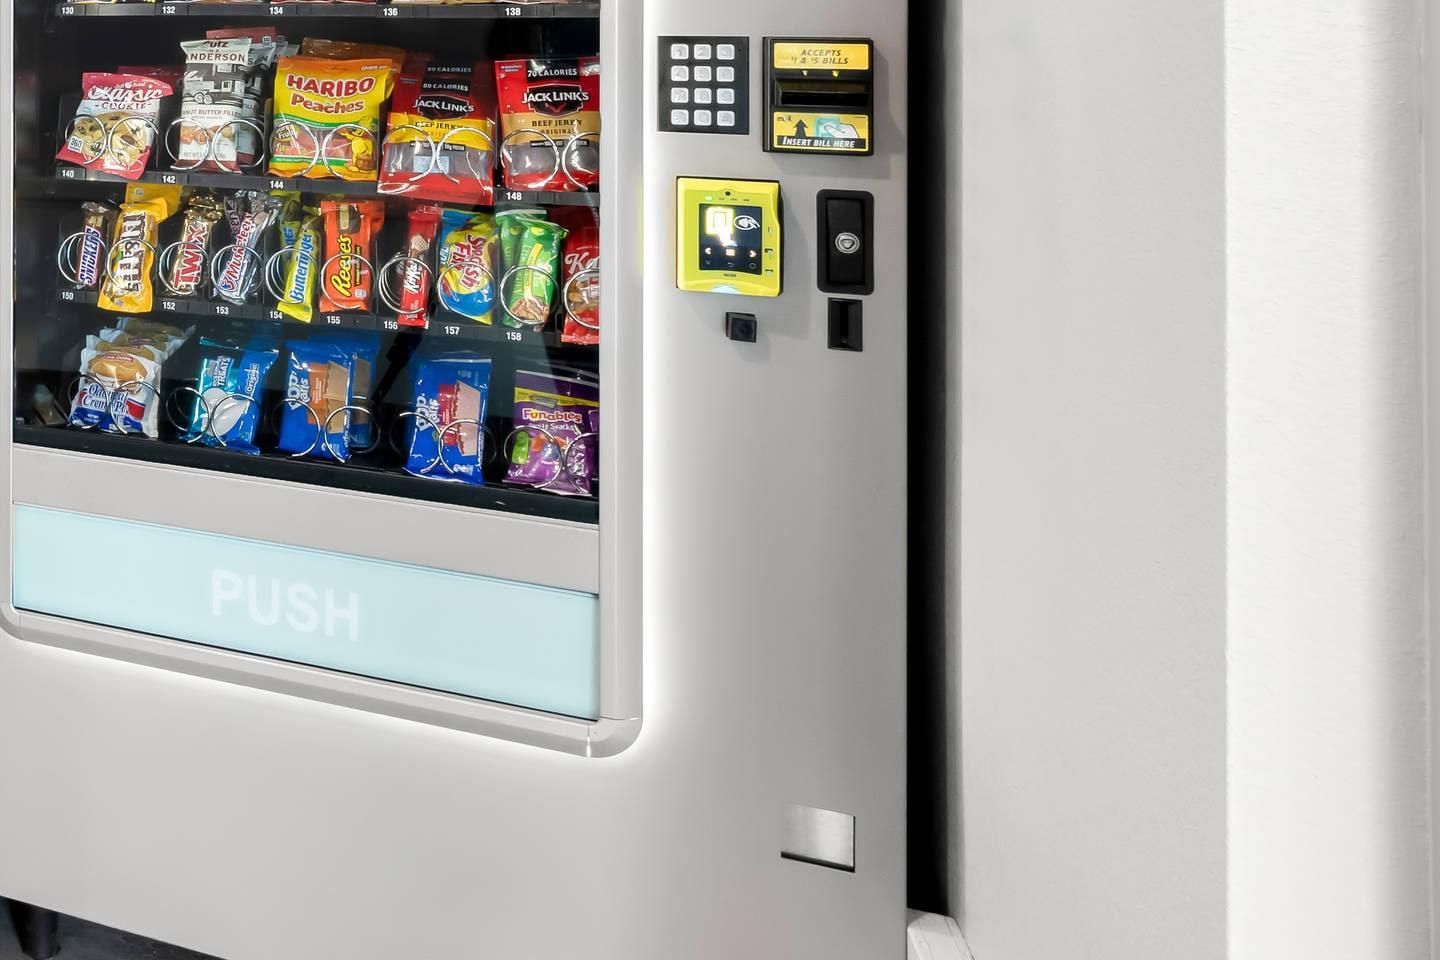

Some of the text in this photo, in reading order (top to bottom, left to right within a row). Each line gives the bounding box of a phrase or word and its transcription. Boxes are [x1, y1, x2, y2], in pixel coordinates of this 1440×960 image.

[270, 7, 283, 15] 134
[383, 8, 398, 16] 136
[505, 8, 521, 16] 138
[538, 68, 577, 77] CALORIES
[287, 74, 376, 97] HARIBO
[433, 83, 469, 91] CALORIES
[522, 92, 552, 103] JACK
[291, 93, 364, 114] Peaches
[412, 100, 440, 109] JACK
[783, 137, 855, 148] INSERT BILL HERE
[270, 181, 283, 189] 144
[506, 192, 522, 201] 148
[80, 226, 101, 284] SNICKERS
[331, 234, 352, 298] Reese's
[62, 292, 74, 300] 150
[162, 302, 175, 310] 152
[216, 306, 229, 314] 153
[270, 311, 283, 319] 154
[327, 316, 340, 324] 155
[384, 322, 398, 330] 156
[444, 326, 460, 335] 157
[506, 332, 522, 340] 158
[218, 357, 231, 386] TREATS
[522, 408, 583, 424] Funables
[210, 569, 359, 640] PUSH
